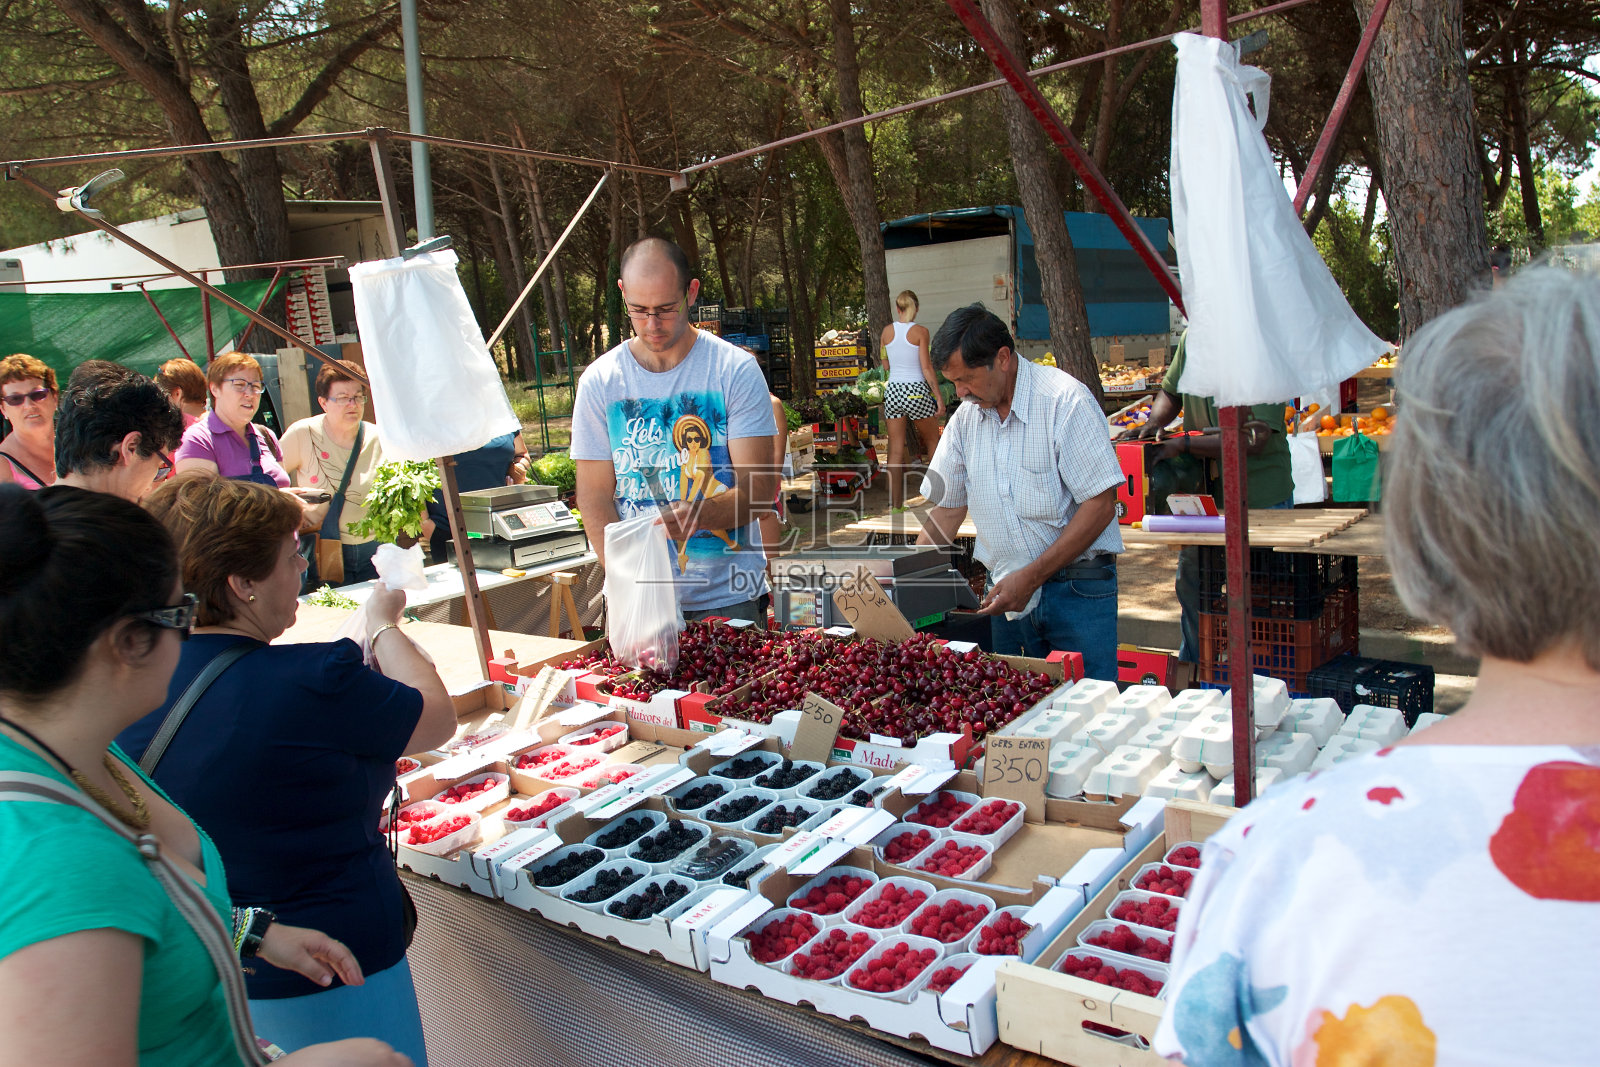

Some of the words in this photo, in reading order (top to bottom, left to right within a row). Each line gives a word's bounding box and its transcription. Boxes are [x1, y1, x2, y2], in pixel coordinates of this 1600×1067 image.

[828, 348, 850, 356] RECIO
[829, 369, 852, 377] RECIO
[613, 448, 642, 475] Do
[804, 701, 832, 723] 2'50
[860, 750, 897, 769] Madu
[988, 753, 1042, 783] 3'50
[822, 821, 845, 836] UMAC
[482, 840, 511, 857] UMAC
[785, 835, 810, 852] UMAC
[685, 903, 714, 924] UMAC
